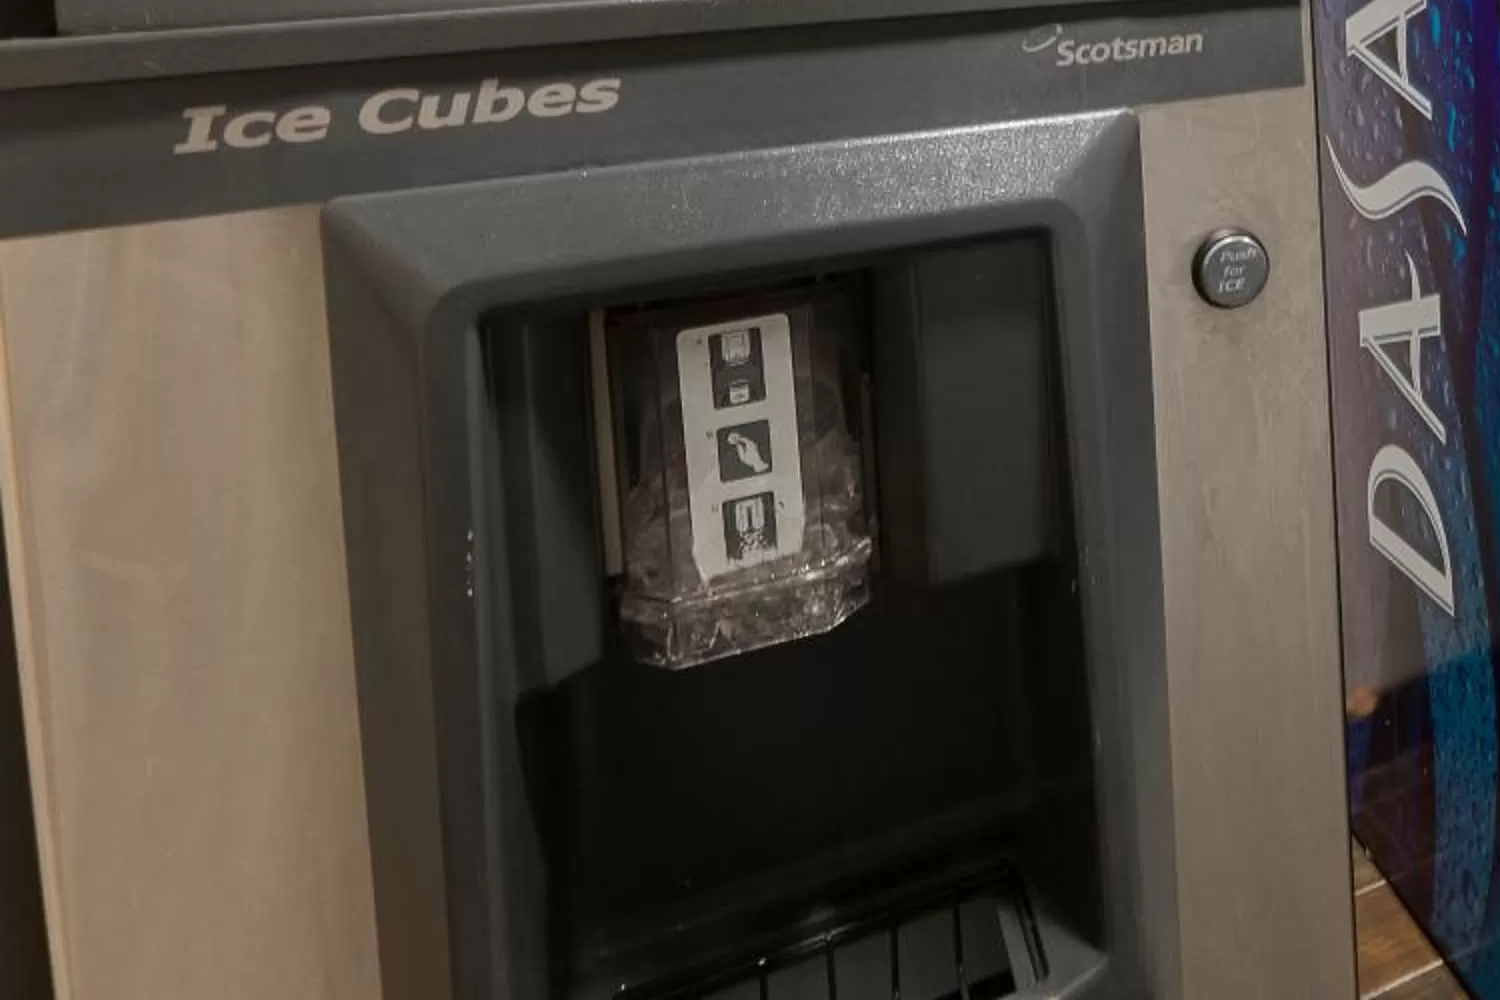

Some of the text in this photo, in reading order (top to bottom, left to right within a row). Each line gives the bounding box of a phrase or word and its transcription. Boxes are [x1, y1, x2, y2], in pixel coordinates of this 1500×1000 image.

[1056, 32, 1203, 67] Scotsman
[172, 77, 621, 155] Ice Cubes
